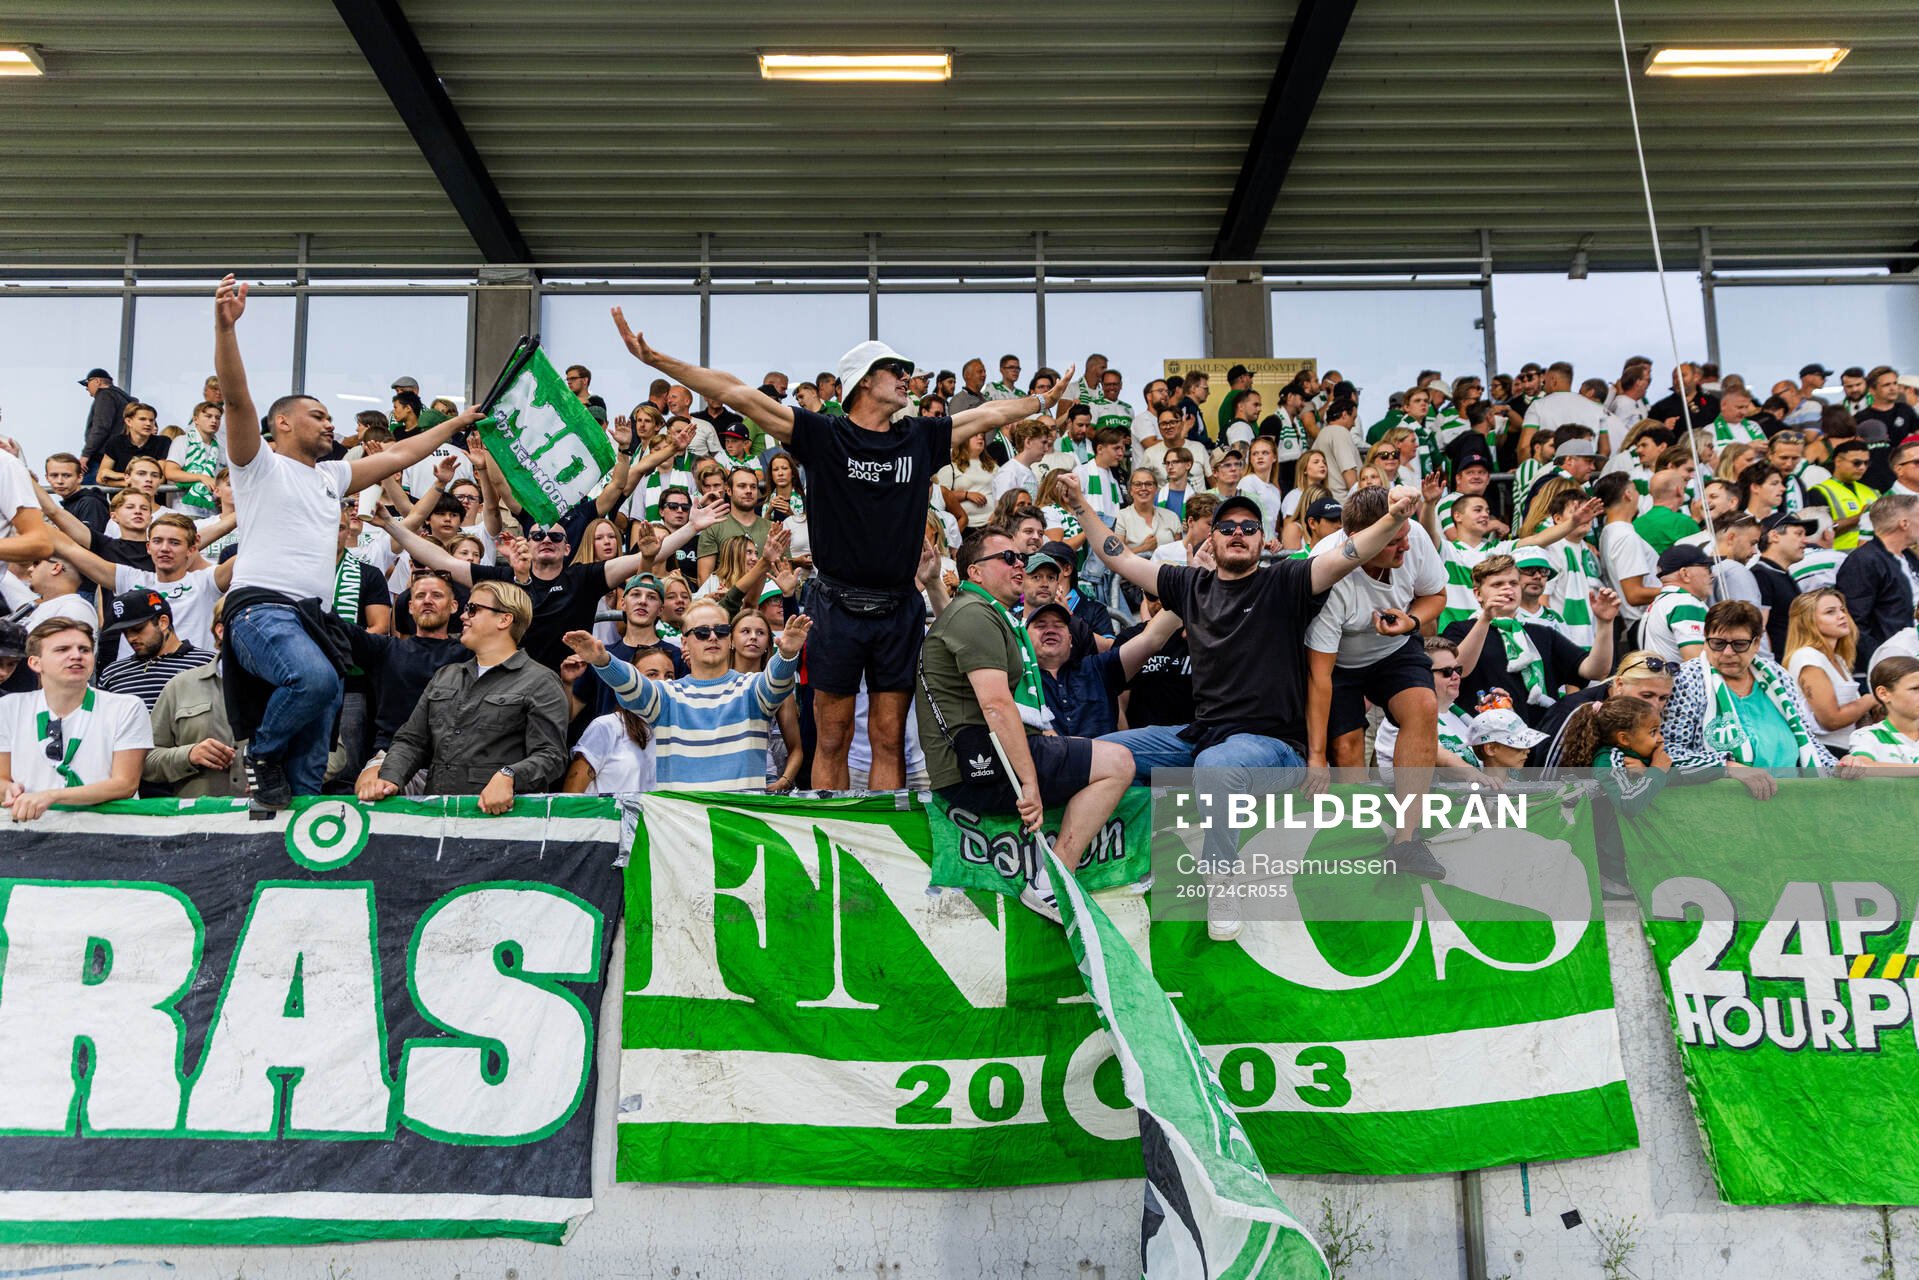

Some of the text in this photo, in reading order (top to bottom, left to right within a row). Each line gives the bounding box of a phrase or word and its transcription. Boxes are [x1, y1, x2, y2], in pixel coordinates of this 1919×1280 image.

[1185, 364, 1228, 372] HIMLEN
[847, 467, 880, 482] 2003
[532, 466, 569, 518] MODE
[970, 769, 995, 778] adidas
[946, 807, 1126, 880] Sain
[624, 793, 1593, 1011] FNCS
